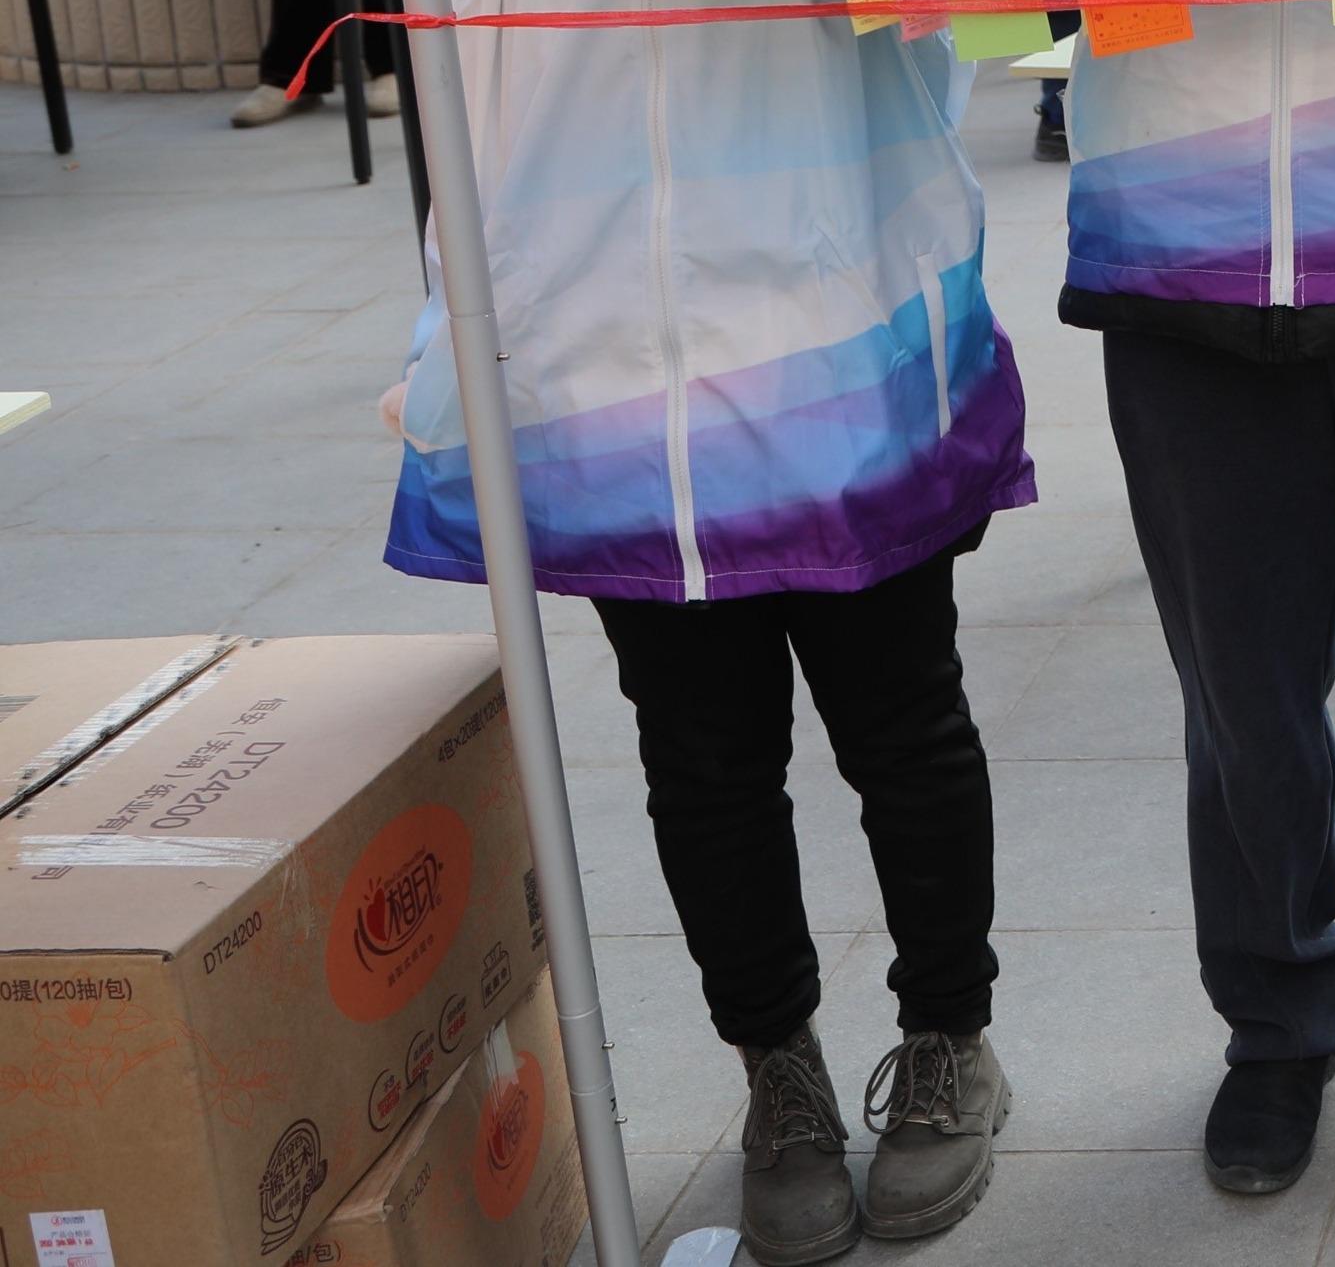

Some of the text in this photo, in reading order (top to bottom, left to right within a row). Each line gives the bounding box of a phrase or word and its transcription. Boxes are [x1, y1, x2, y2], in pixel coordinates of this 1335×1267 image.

[151, 742, 286, 829] DT24200
[203, 911, 262, 975] DT24200
[400, 1162, 432, 1222] DT24200
